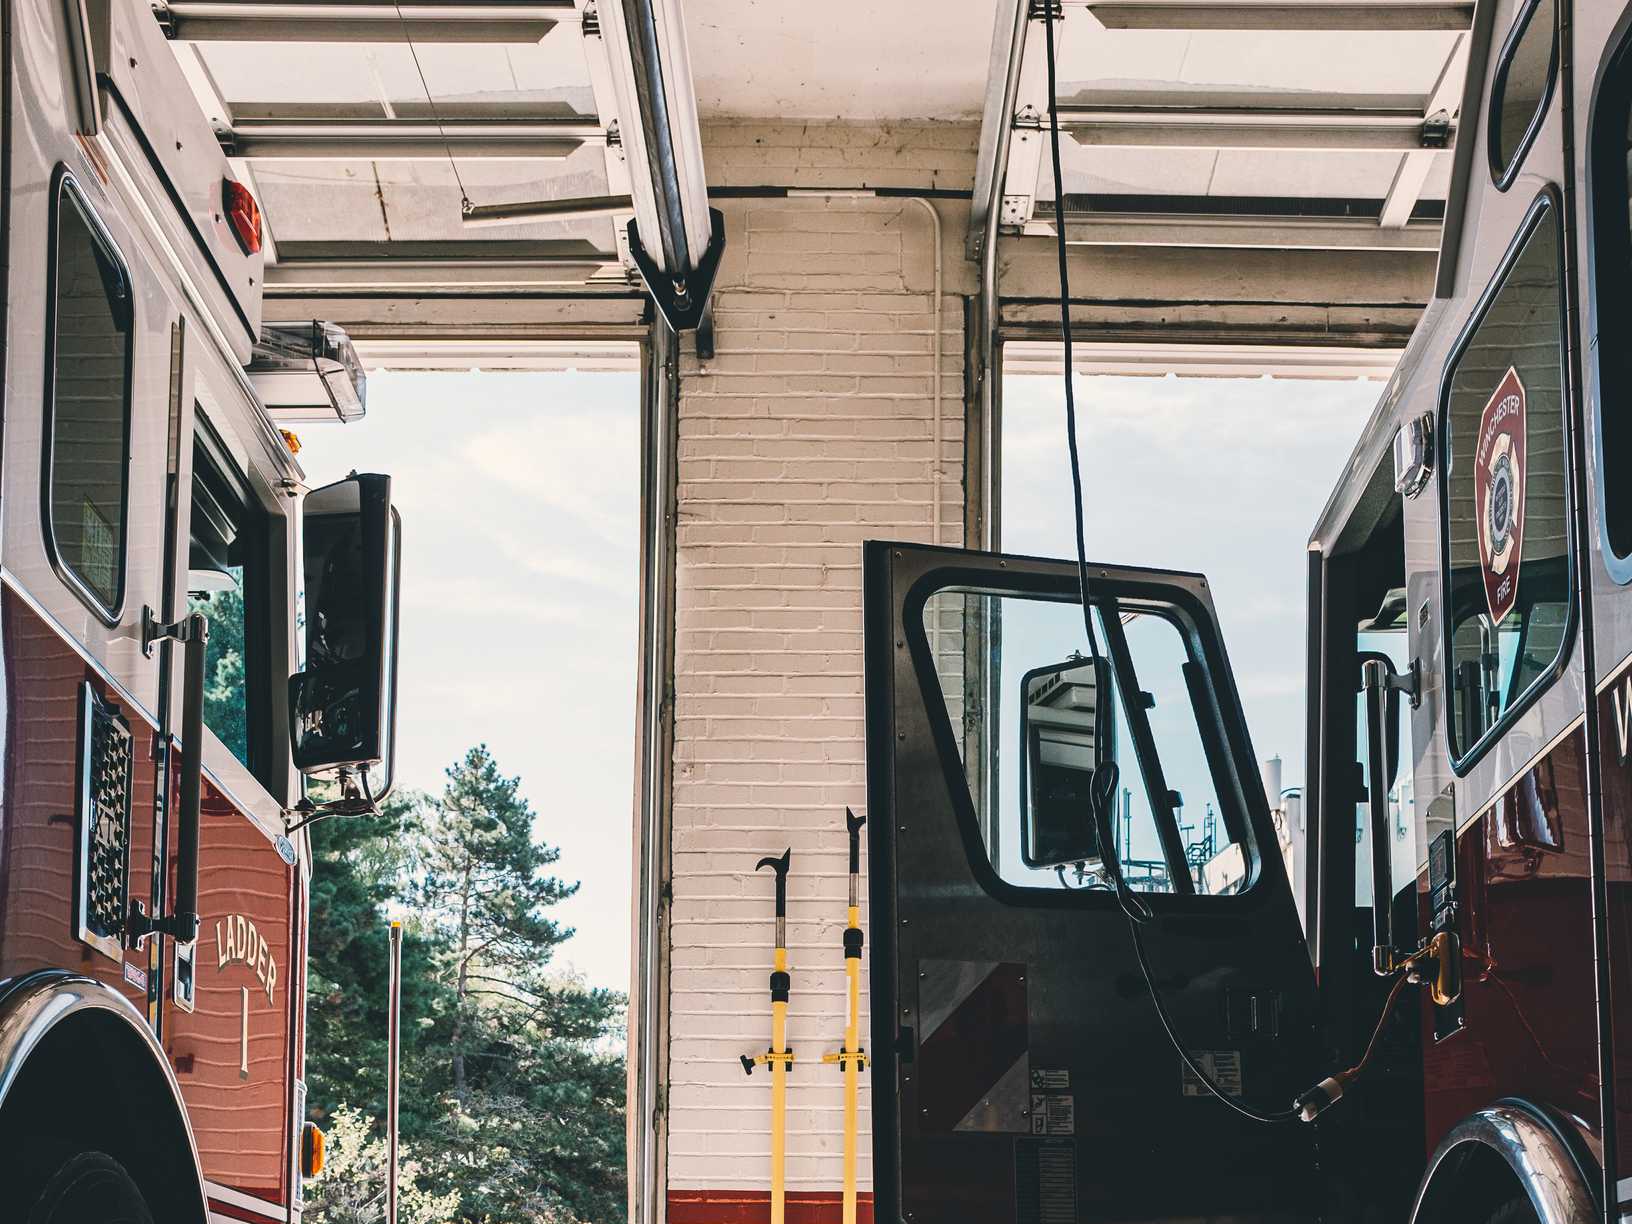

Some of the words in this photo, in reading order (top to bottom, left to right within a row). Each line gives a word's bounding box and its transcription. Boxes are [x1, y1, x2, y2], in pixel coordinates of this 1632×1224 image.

[1479, 395, 1520, 467] WINCHESTER
[1497, 576, 1511, 604] FIRE
[216, 914, 277, 1006] LADDER
